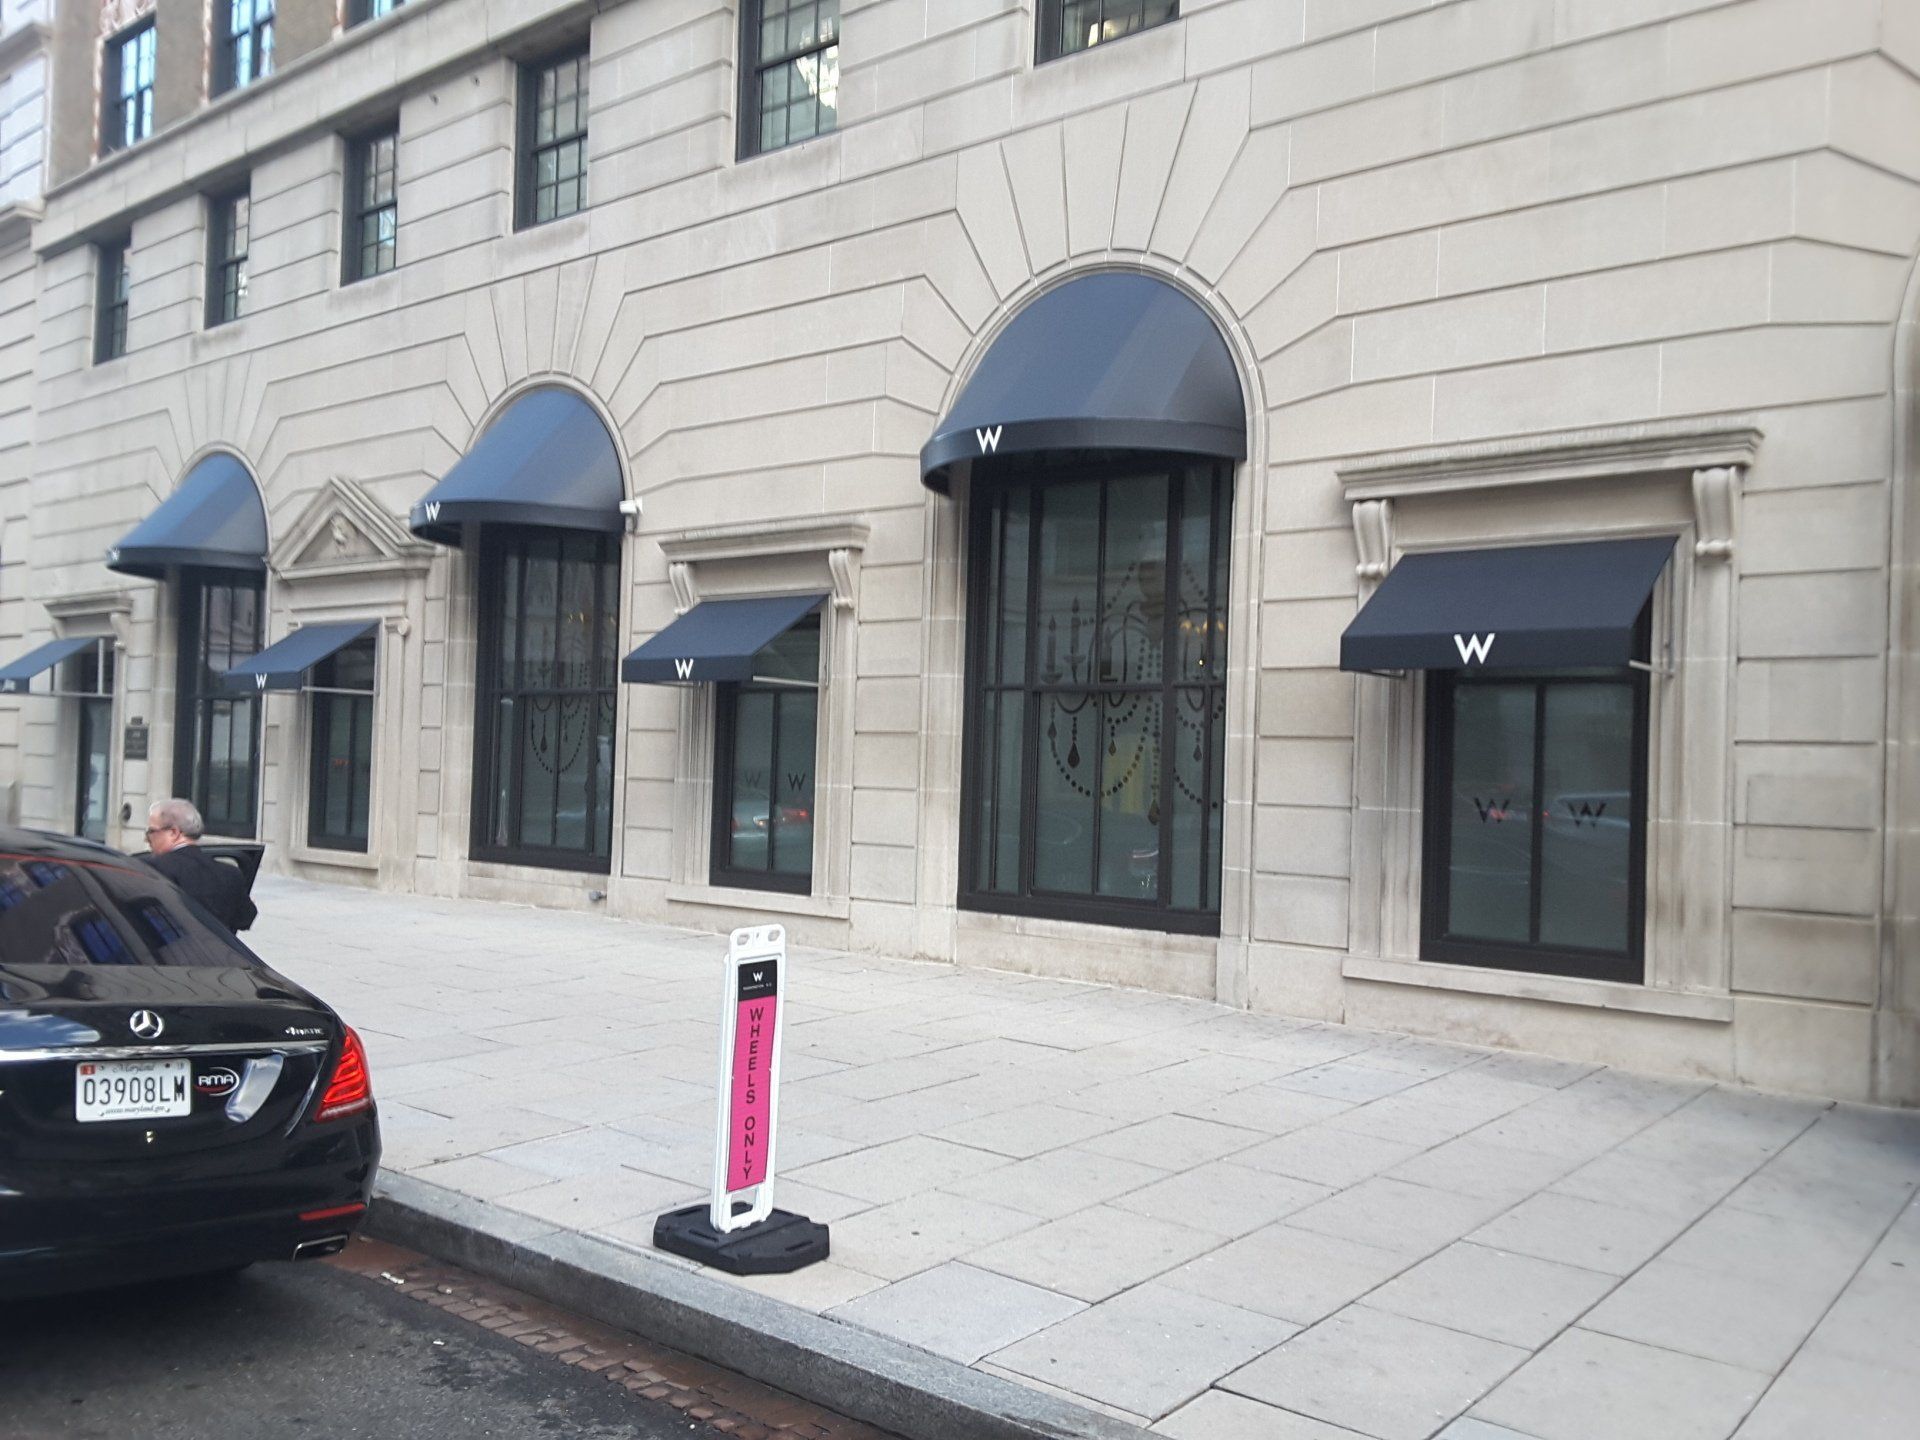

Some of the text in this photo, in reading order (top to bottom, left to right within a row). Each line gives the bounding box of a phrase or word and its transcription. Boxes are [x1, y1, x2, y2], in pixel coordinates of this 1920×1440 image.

[976, 425, 1003, 455] W
[425, 501, 441, 522] W
[1453, 633, 1496, 665] W
[255, 672, 267, 689] W
[674, 658, 694, 680] W
[787, 773, 806, 791] W
[1474, 798, 1510, 823] W
[1567, 802, 1607, 828] W
[752, 971, 763, 982] W
[745, 1007, 765, 1105] WHEELS
[743, 1116, 756, 1181] ONLY
